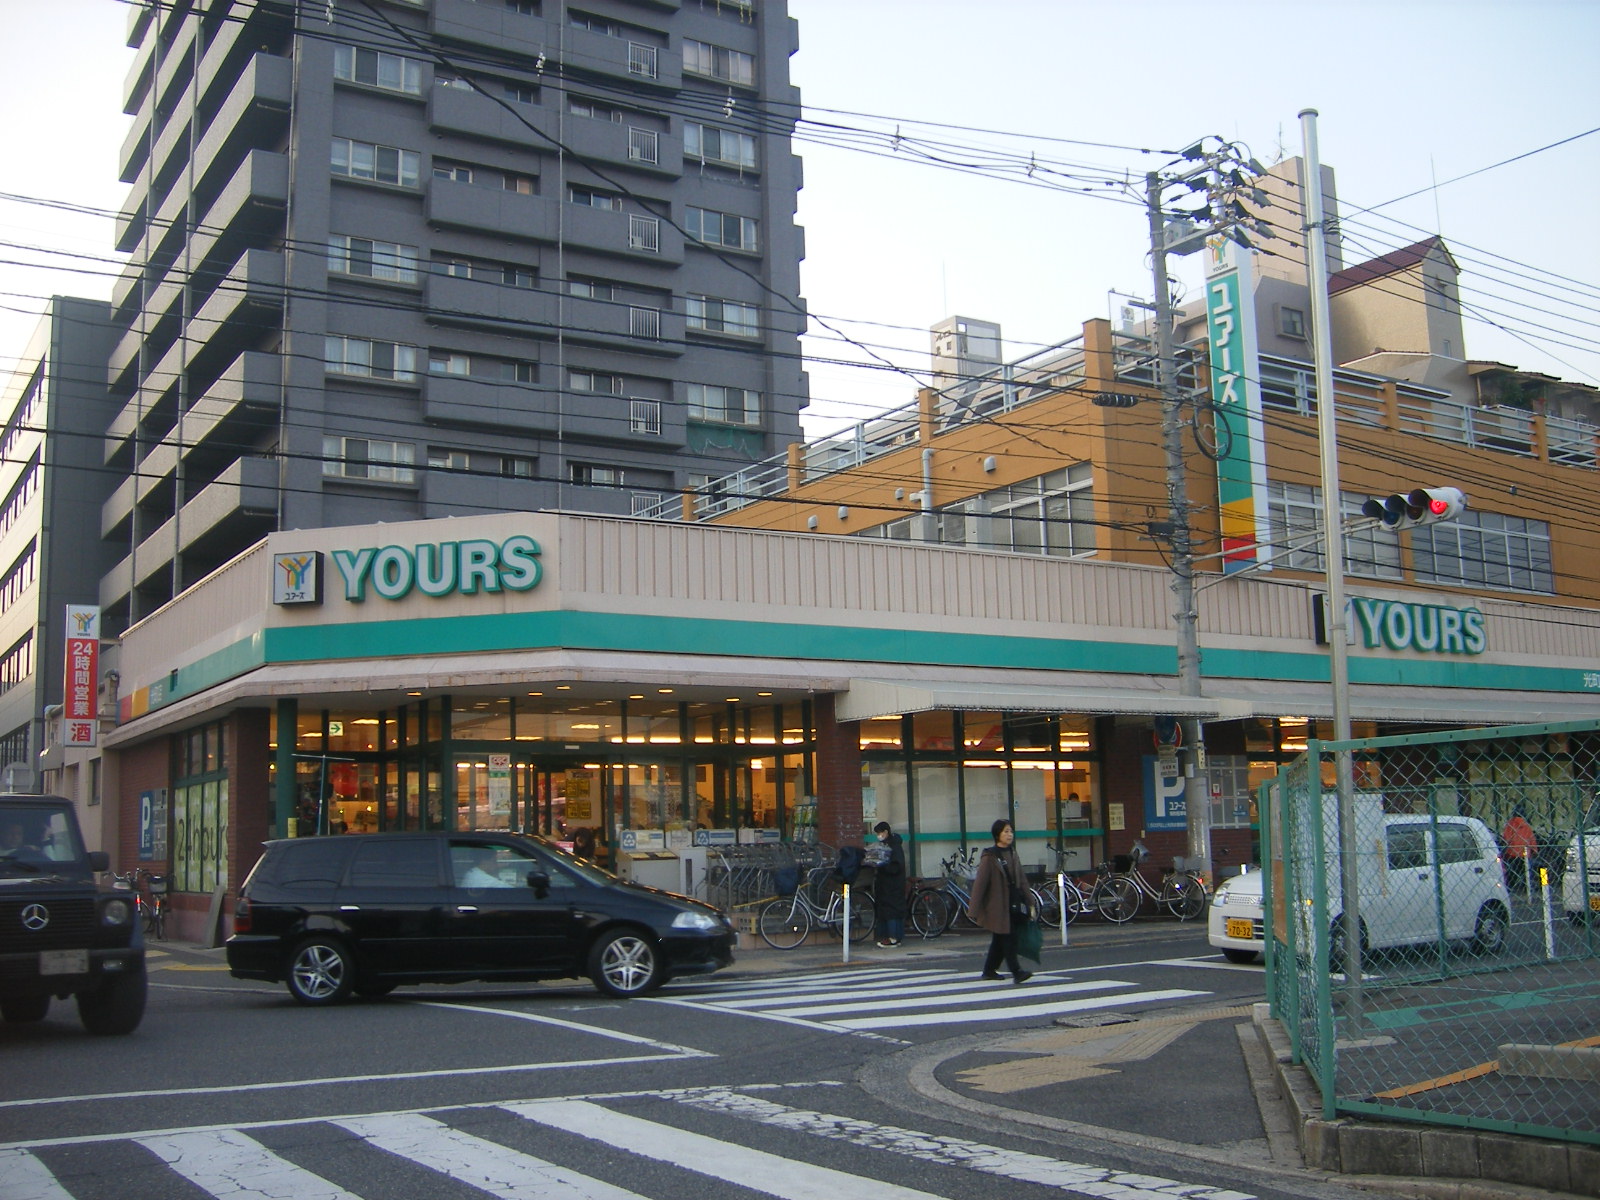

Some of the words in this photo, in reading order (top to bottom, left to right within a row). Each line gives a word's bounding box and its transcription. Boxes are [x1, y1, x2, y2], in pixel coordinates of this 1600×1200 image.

[1212, 263, 1228, 272] YOURS
[1212, 282, 1240, 406] ユアーズ
[331, 535, 543, 602] YOURS
[1352, 597, 1487, 655] YOURS
[71, 723, 91, 742] 酒
[1154, 761, 1185, 817] P
[142, 797, 151, 849] P
